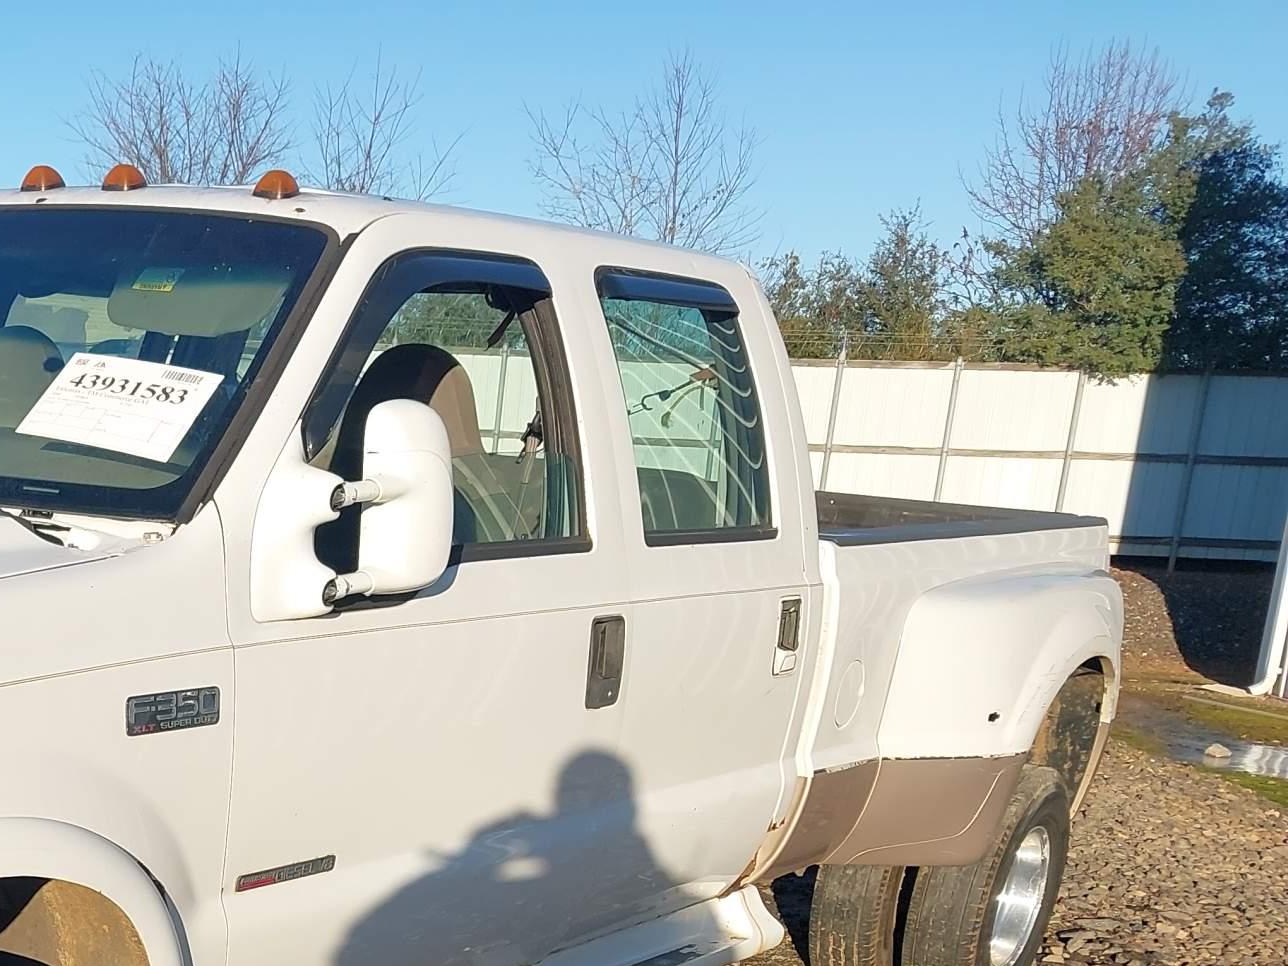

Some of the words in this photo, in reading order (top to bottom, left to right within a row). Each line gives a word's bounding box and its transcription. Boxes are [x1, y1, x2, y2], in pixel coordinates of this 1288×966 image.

[70, 373, 189, 405] 43931583
[128, 688, 219, 724] F-350
[133, 723, 156, 734] XLT
[160, 717, 192, 729] SUPER
